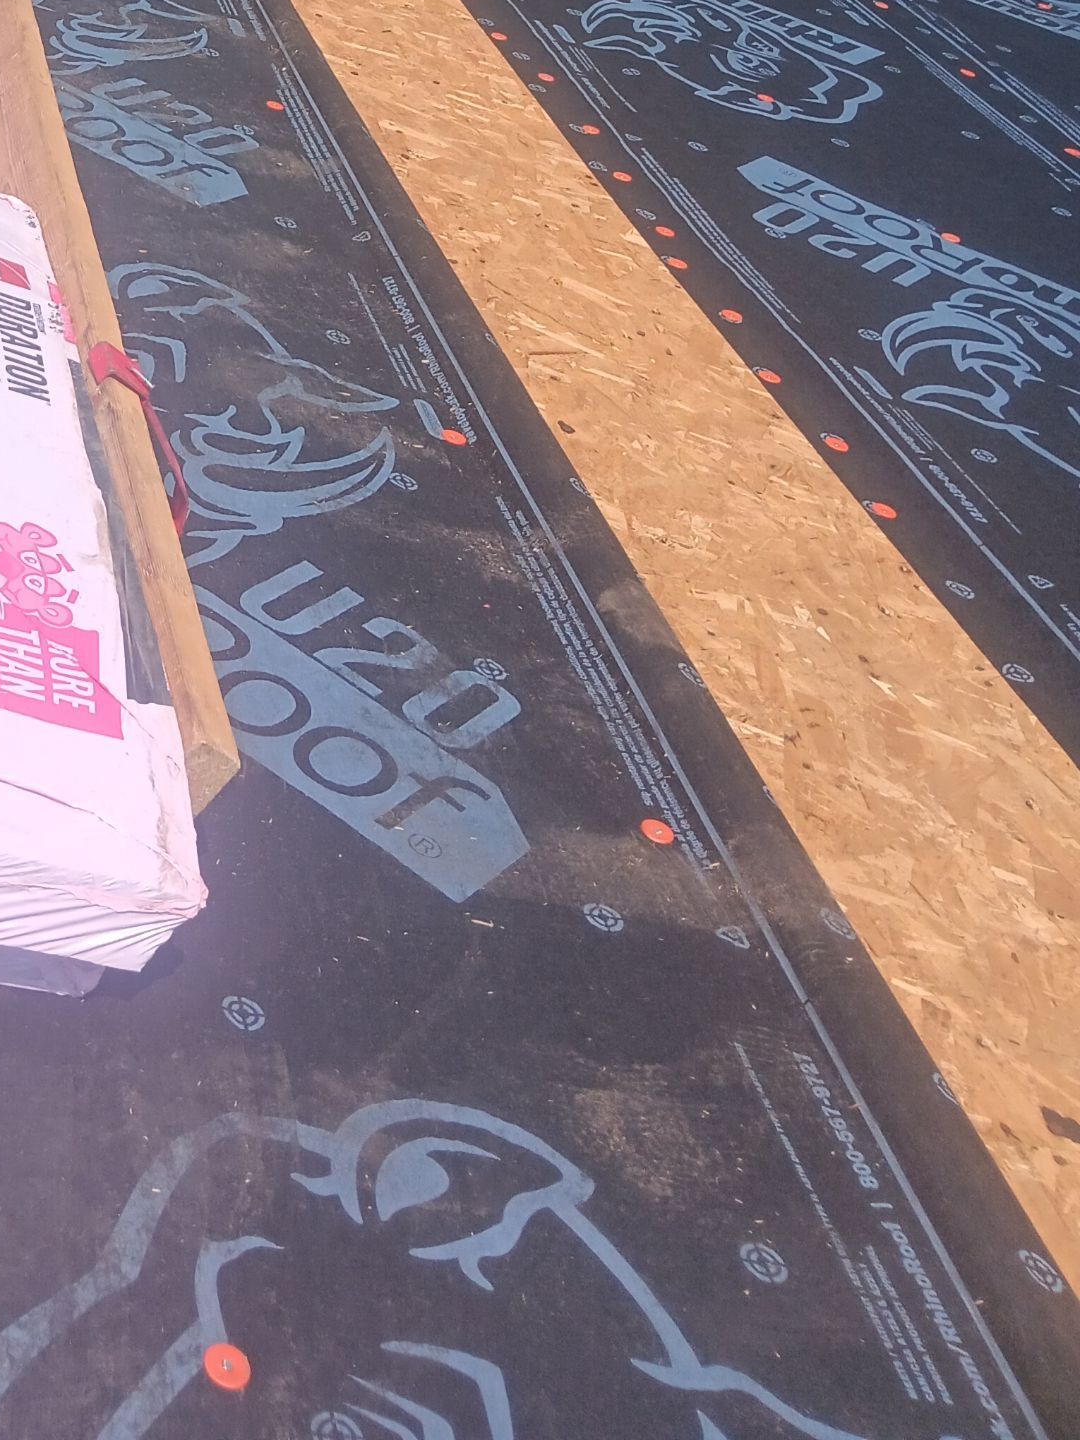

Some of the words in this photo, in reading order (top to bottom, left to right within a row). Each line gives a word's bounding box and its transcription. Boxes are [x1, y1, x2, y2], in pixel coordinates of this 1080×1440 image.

[91, 78, 260, 156] U20
[752, 202, 931, 287] U20
[240, 560, 520, 748] U20
[791, 1051, 881, 1188] 800-567-9727
[890, 1300, 929, 1351] PRODUCT
